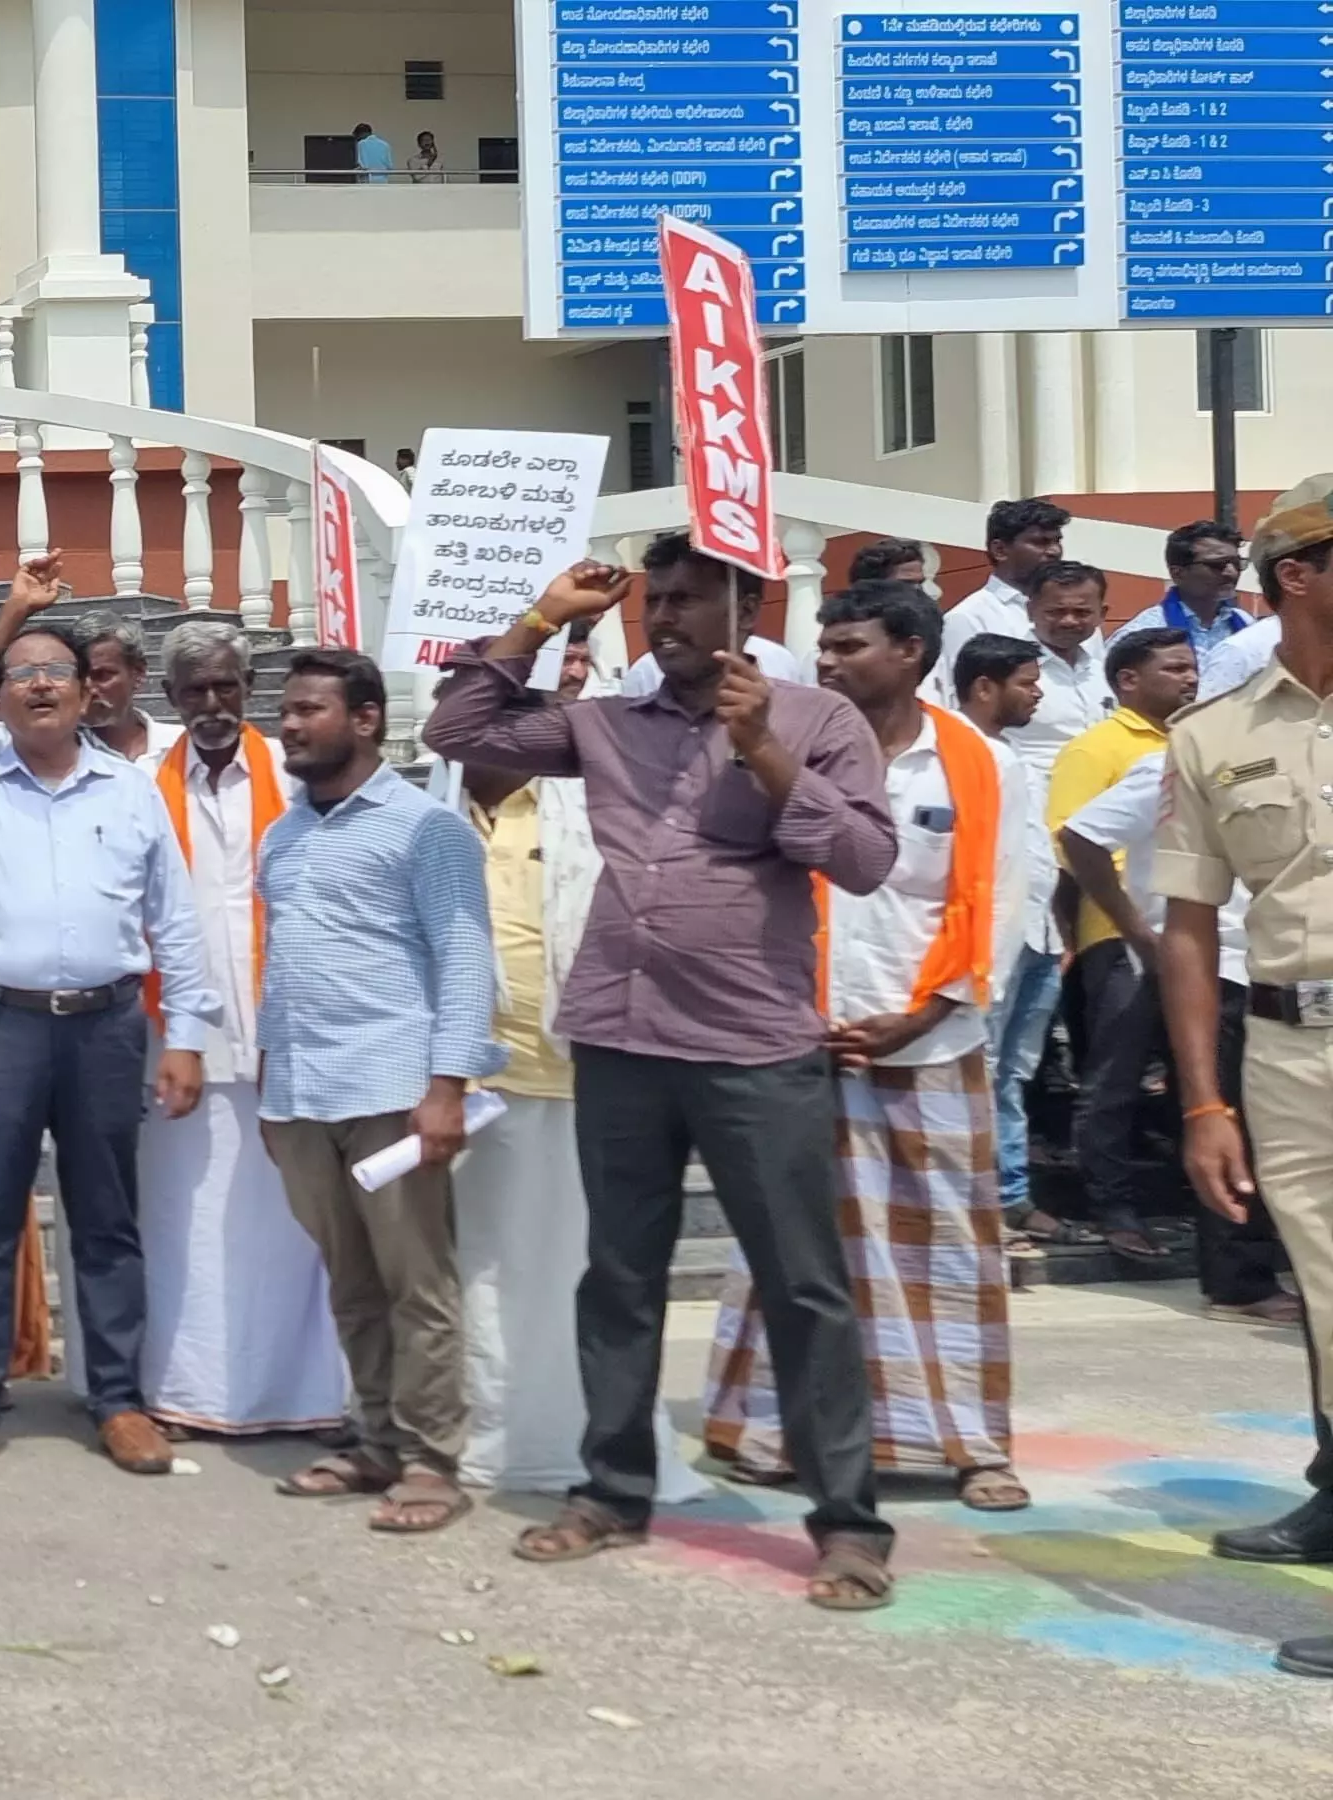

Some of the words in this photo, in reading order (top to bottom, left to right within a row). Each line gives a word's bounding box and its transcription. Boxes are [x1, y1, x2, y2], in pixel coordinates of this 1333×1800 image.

[684, 252, 765, 552] AIKKMS
[441, 450, 522, 469] ಕೂಡಲೇ
[526, 455, 580, 481] ಎಲ್ಲಾ
[521, 484, 576, 512] ಮತ್ತು
[434, 540, 470, 565] ಹತ್ತಿ
[474, 544, 543, 566] ಖರೀದಿ
